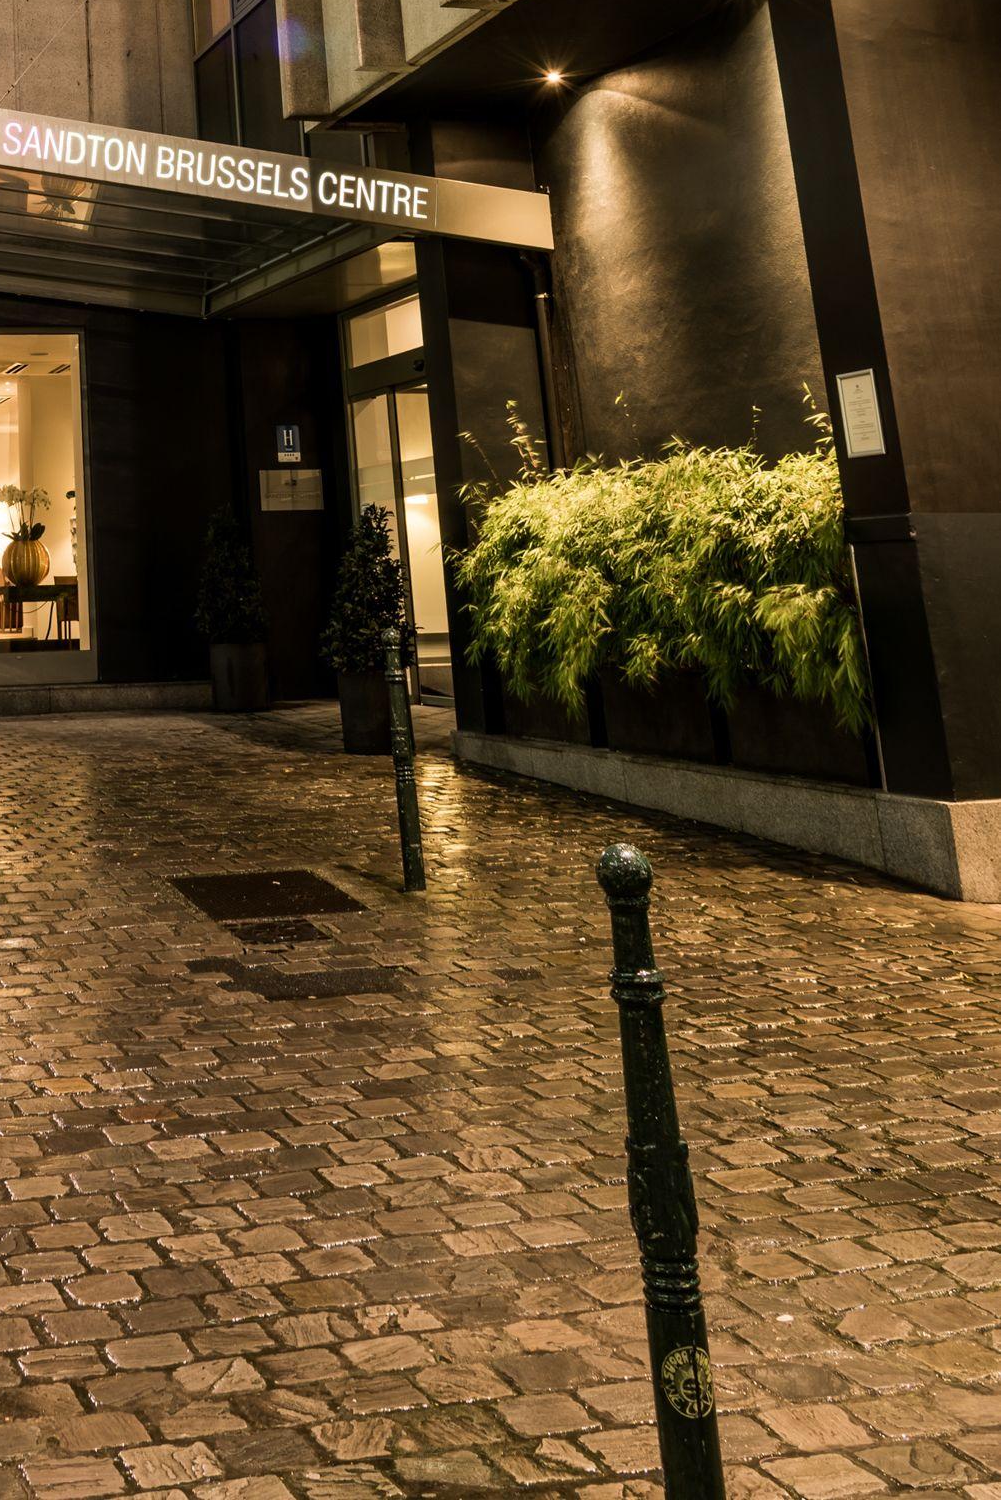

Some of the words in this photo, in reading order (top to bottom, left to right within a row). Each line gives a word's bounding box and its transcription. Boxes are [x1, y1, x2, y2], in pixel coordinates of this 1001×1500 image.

[2, 121, 146, 176] SANDTON
[156, 145, 309, 201] BRUSSELS
[318, 171, 429, 219] CENTRE
[283, 429, 294, 446] H
